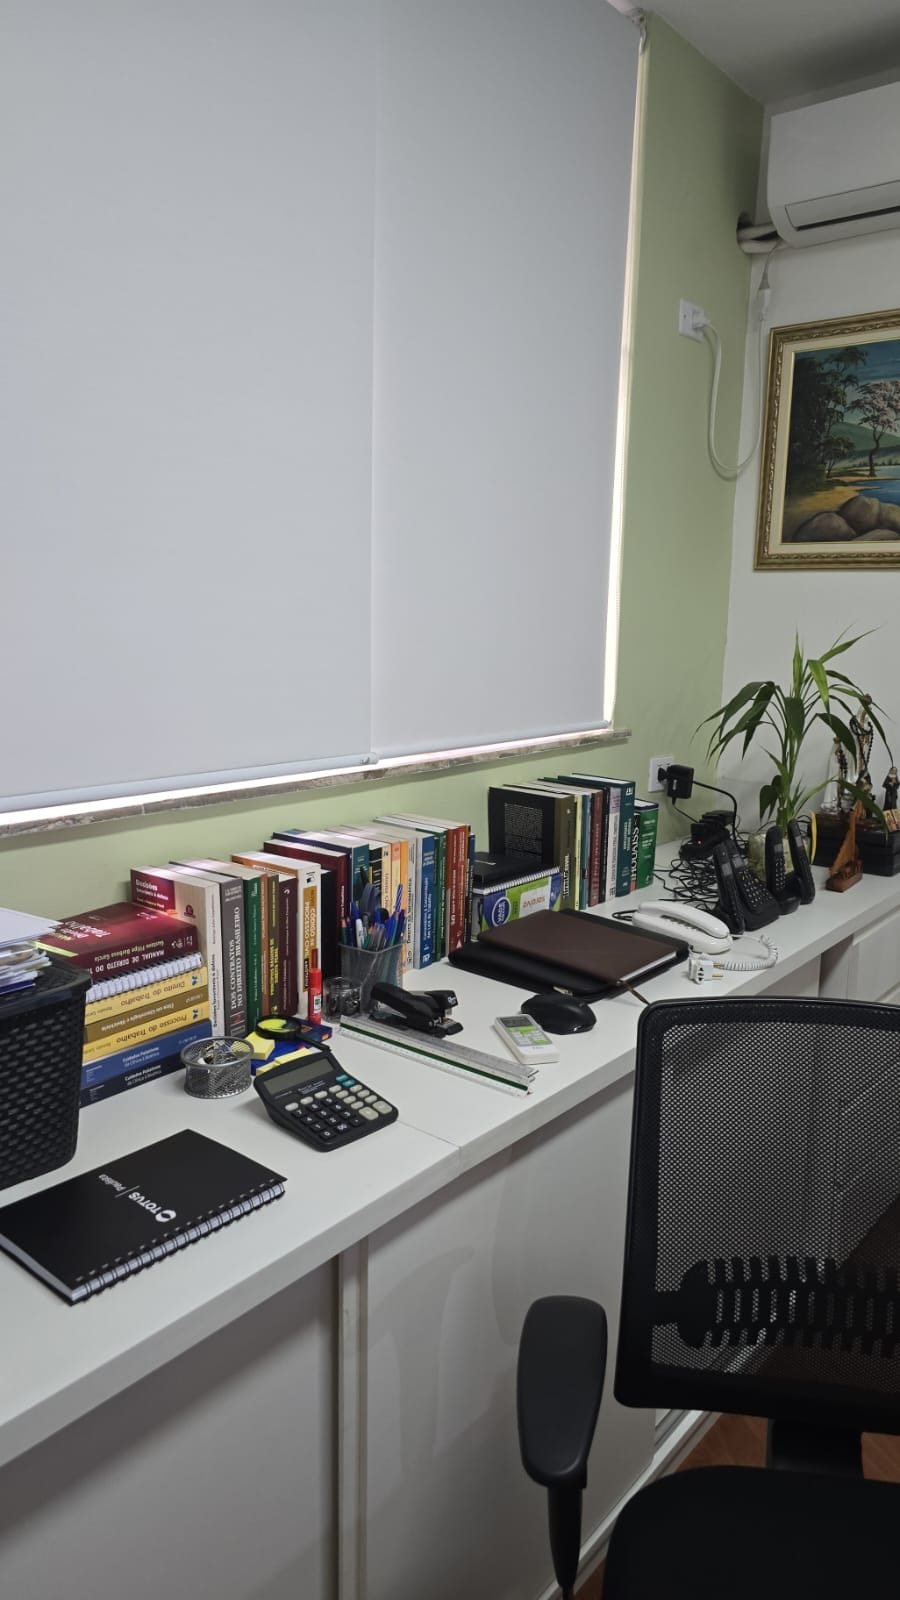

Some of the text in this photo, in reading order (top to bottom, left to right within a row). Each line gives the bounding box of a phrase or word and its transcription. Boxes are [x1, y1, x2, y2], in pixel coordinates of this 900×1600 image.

[106, 959, 129, 971] DIREITO
[131, 955, 140, 964] DE
[141, 950, 165, 961] MANUAL
[229, 939, 237, 991] CONTRATOS
[233, 906, 243, 1007] NO DIREITO BRASILEIRO
[95, 964, 104, 973] DO
[120, 981, 186, 1006] Direito do Trabalho
[116, 1015, 187, 1044] Processo do Trabalho
[128, 1192, 161, 1214] TOTUS
